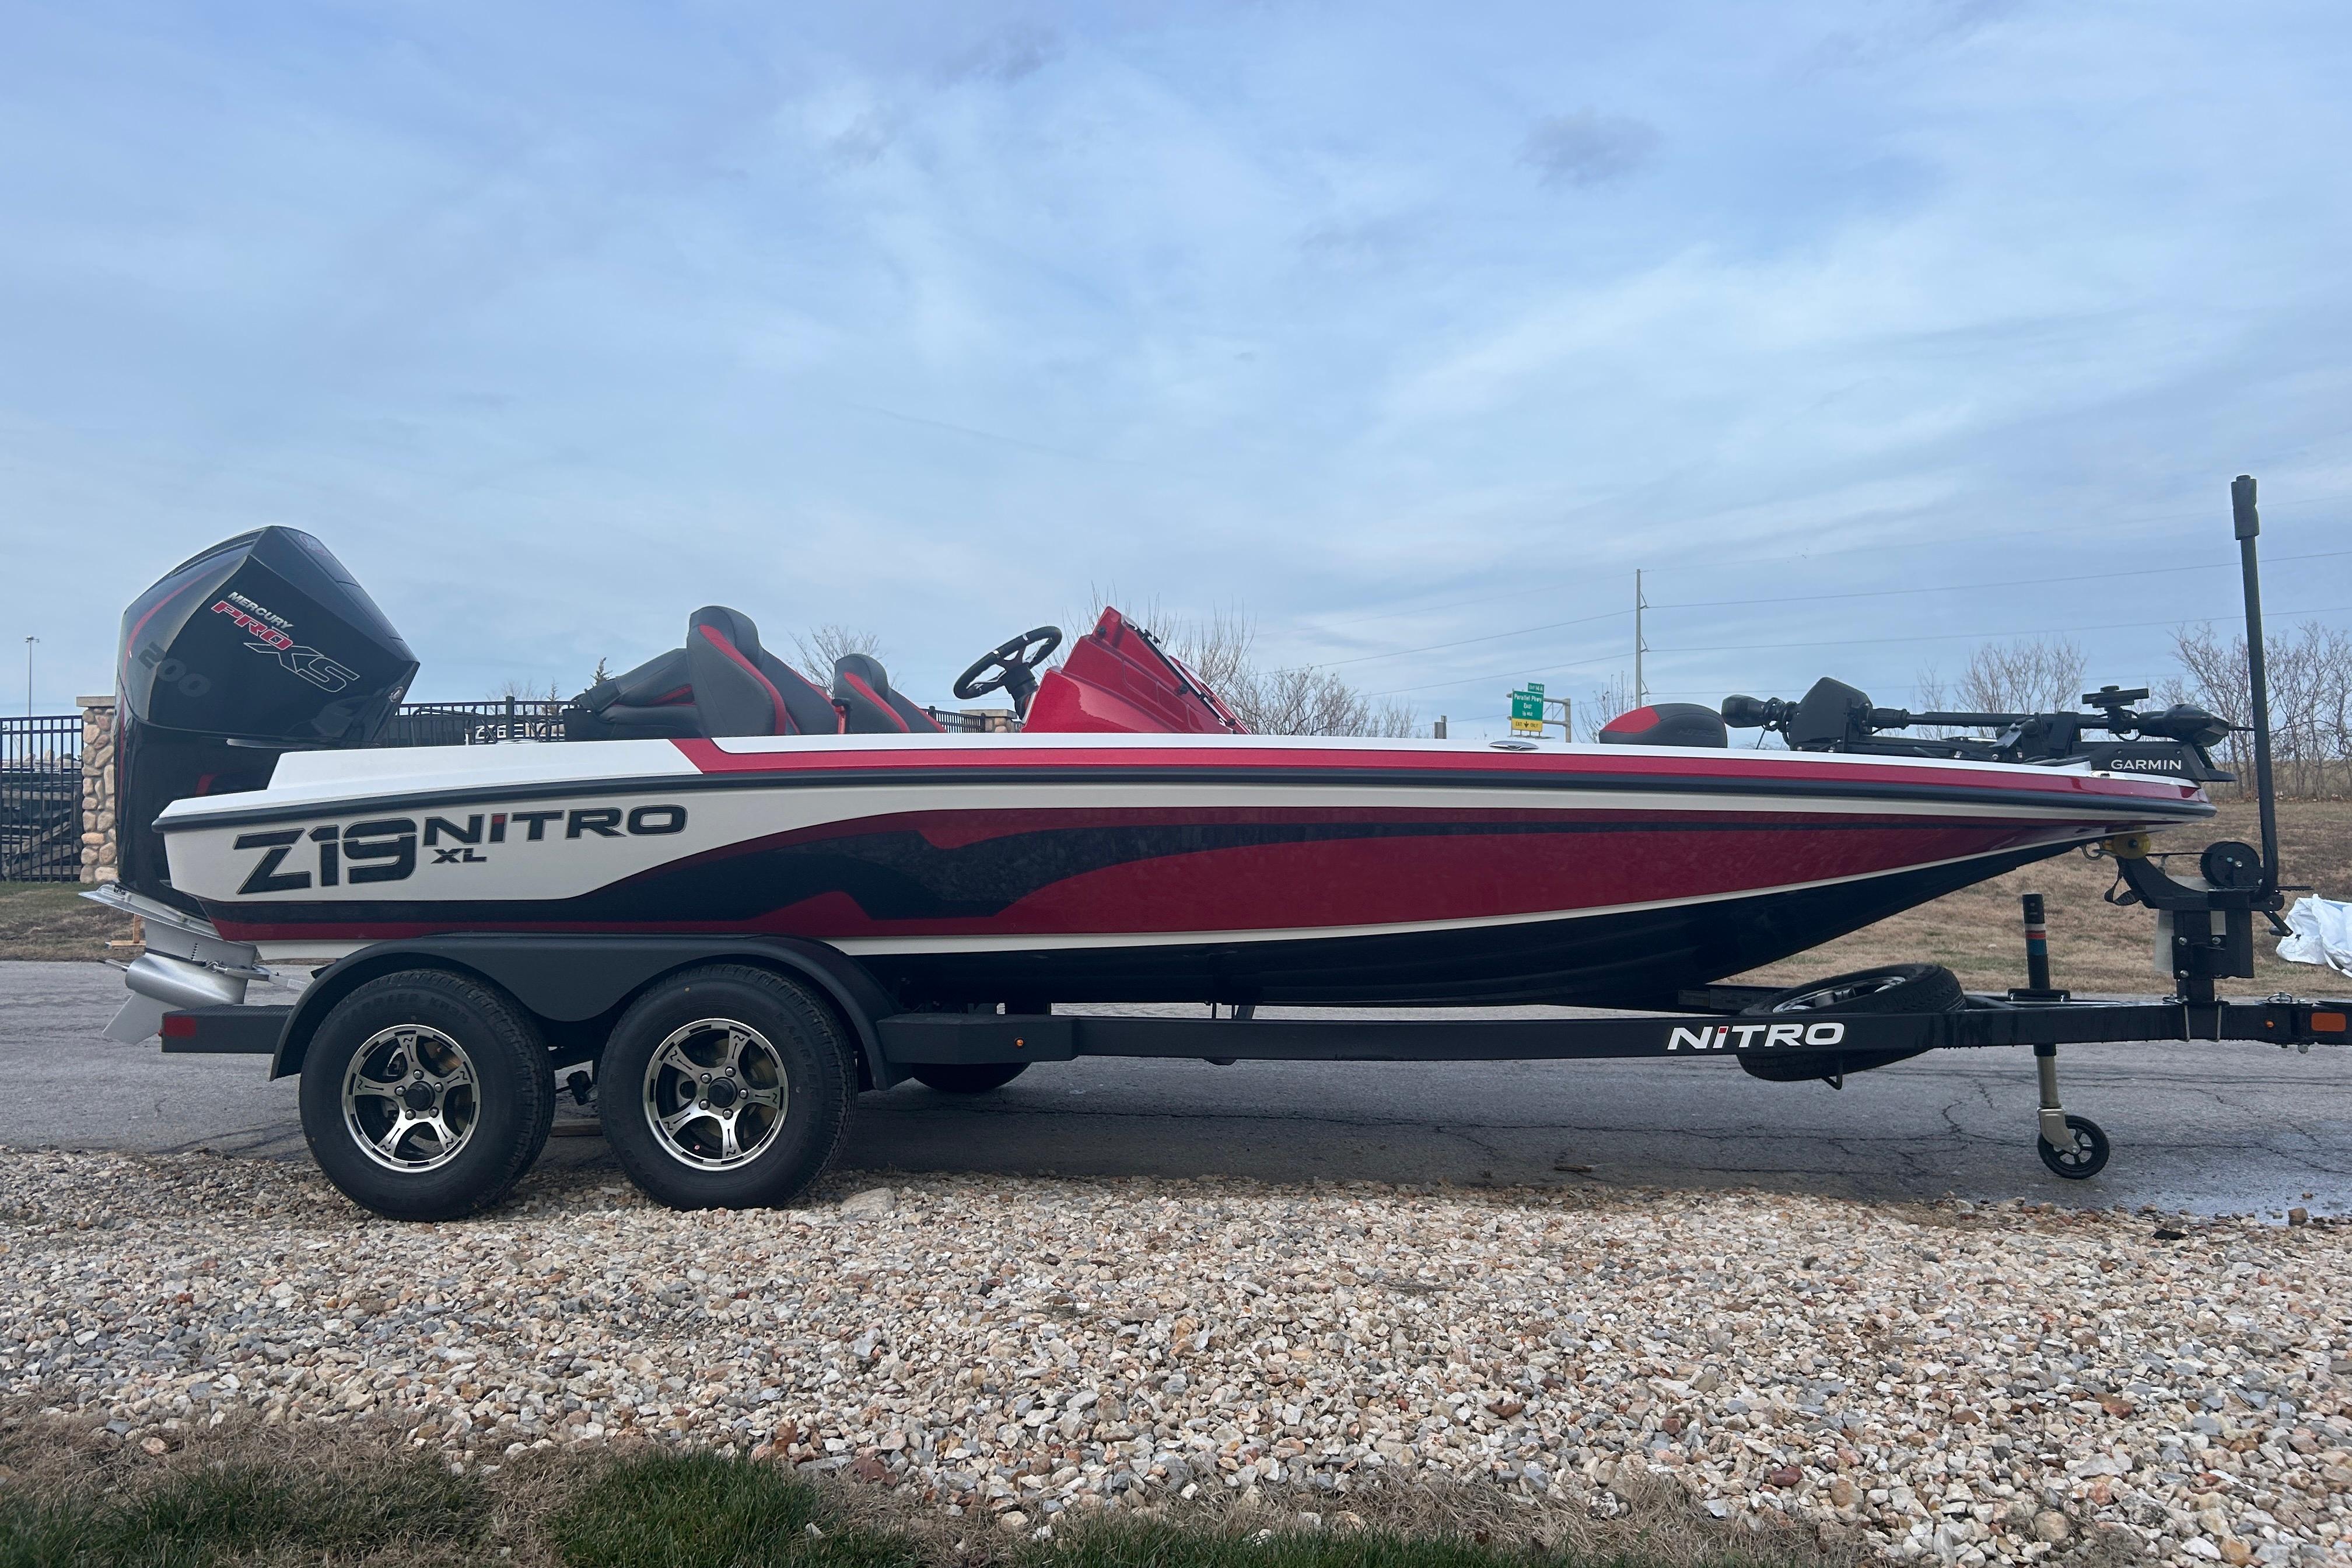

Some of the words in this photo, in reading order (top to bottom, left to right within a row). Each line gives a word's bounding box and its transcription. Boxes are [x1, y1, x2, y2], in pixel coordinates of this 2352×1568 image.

[211, 600, 293, 650] PRO
[228, 592, 294, 629] MERCURY
[138, 641, 211, 698] 200
[243, 626, 360, 692] XS
[1514, 693, 1530, 701] Parallel
[1531, 695, 1542, 704] Pkwy
[2110, 759, 2182, 771] GARMIN
[233, 817, 418, 895] Z19
[422, 804, 688, 848] NITRO
[430, 848, 488, 864] XL
[1667, 1022, 1846, 1051] NITRO
